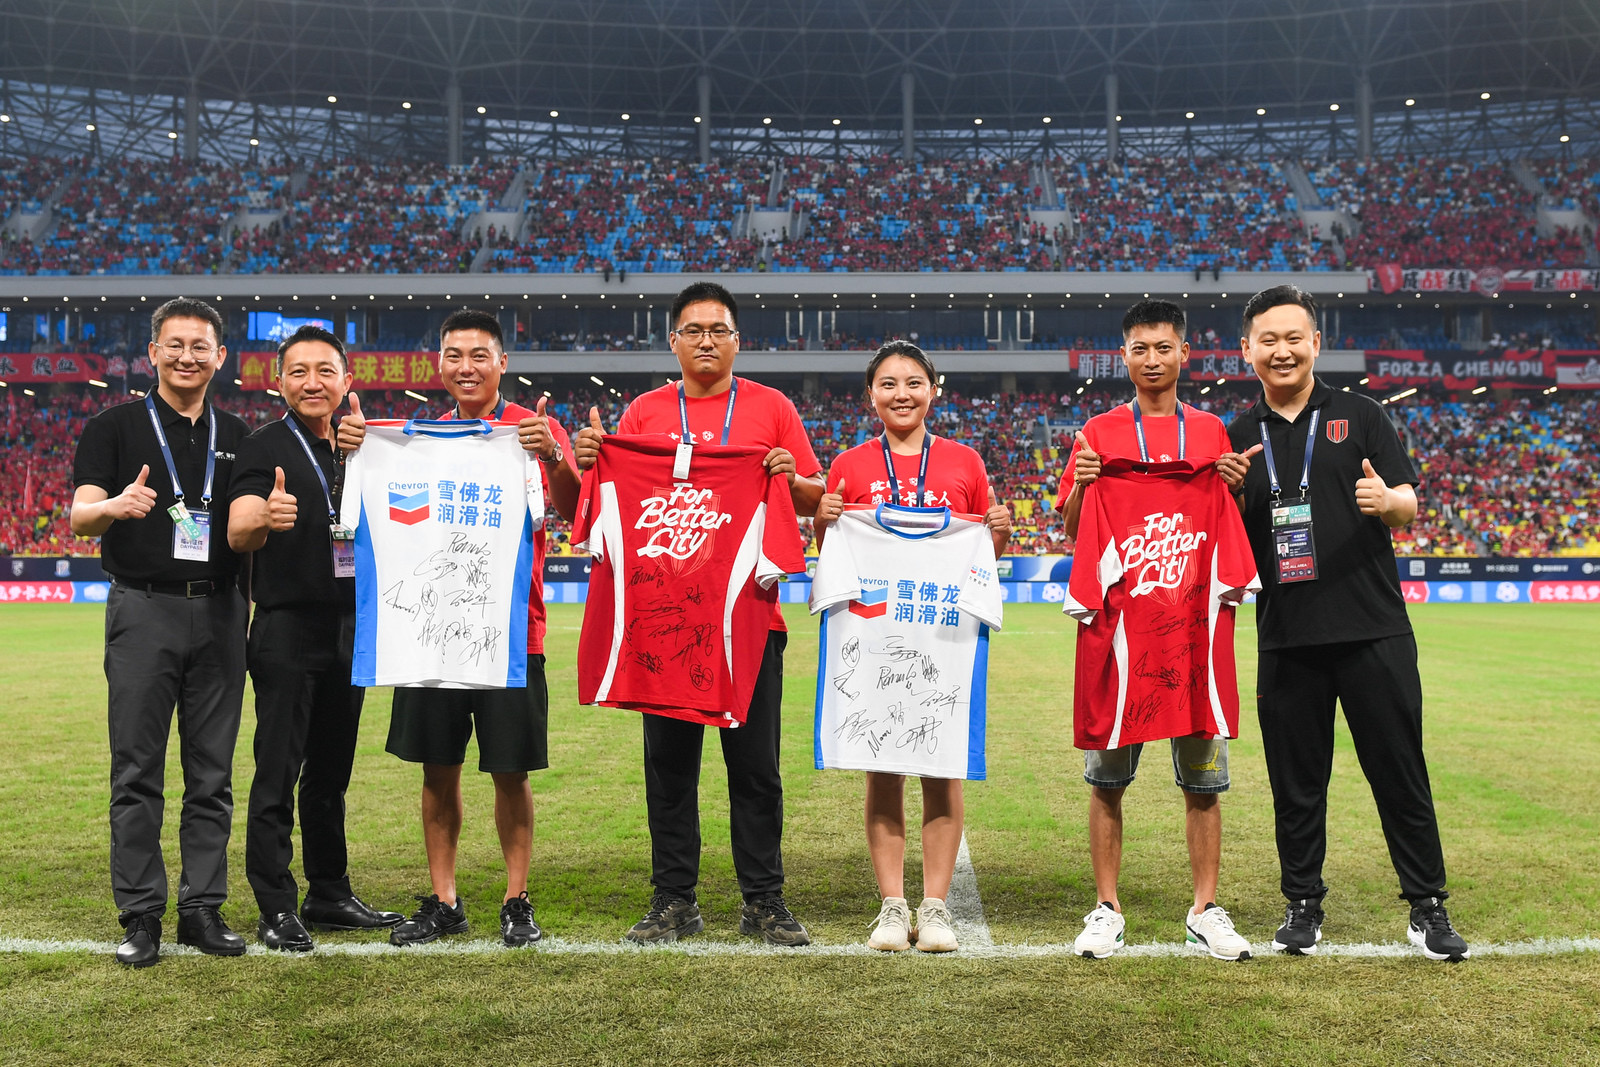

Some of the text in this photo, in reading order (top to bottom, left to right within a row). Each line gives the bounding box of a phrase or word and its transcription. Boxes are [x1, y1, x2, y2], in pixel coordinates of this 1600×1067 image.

[353, 355, 435, 383] 球迷协
[1378, 360, 1543, 377] FORZA CHENGDU
[388, 481, 429, 490] Chevron
[437, 480, 503, 504] 雪佛龙
[668, 483, 713, 506] For
[437, 503, 502, 529] 润滑油
[634, 497, 732, 530] Better
[1144, 512, 1183, 540] For
[636, 527, 708, 560] City
[1120, 530, 1207, 572] Better
[857, 575, 889, 586] hevron
[1130, 555, 1188, 598] City
[897, 579, 960, 604] 雪佛龙
[895, 602, 960, 627] 润滑油
